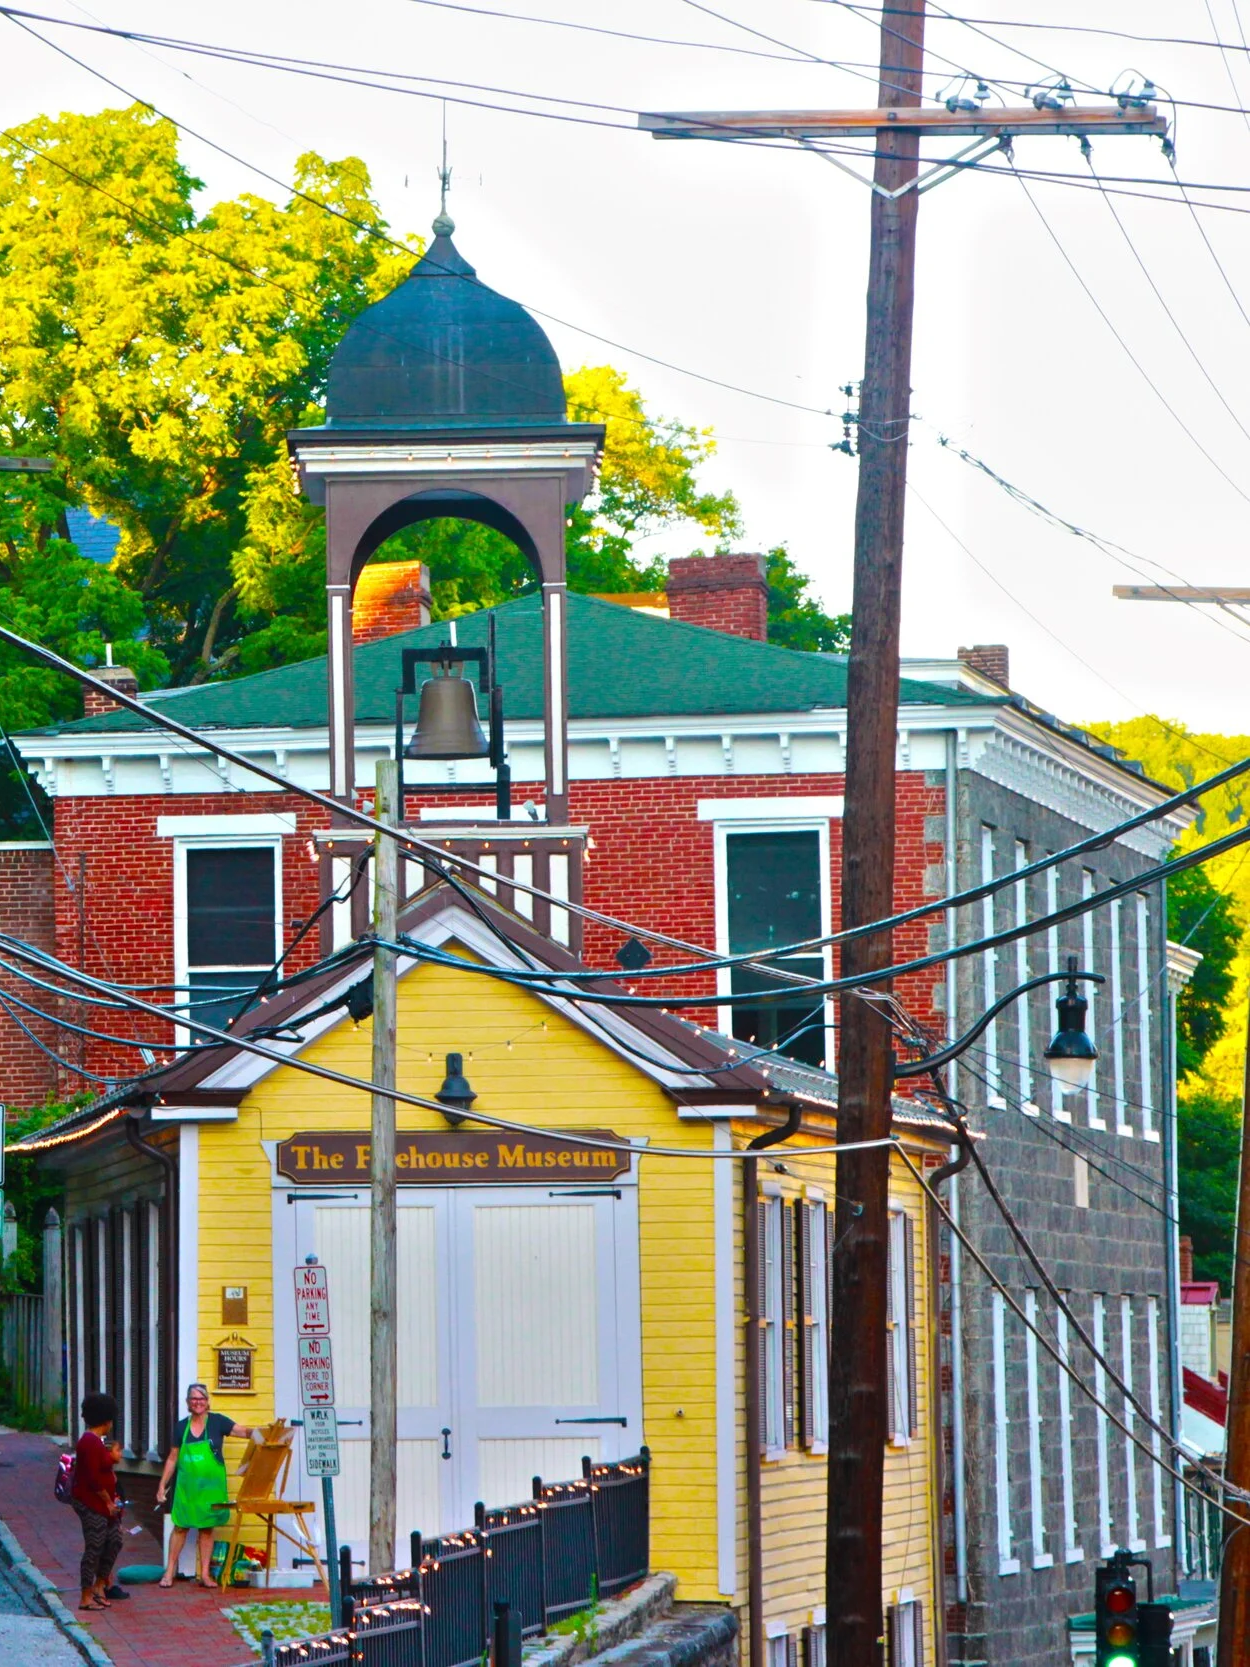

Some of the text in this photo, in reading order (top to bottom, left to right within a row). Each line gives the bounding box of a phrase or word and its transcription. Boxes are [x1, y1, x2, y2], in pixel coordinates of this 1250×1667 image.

[291, 1144, 617, 1169] The Fehouse Museum
[304, 1272, 317, 1285] NO
[296, 1287, 326, 1300] PARKING
[306, 1302, 318, 1311] ANY
[305, 1312, 321, 1321] TIME
[308, 1341, 320, 1354] NO
[301, 1357, 330, 1369] PARKING
[304, 1371, 329, 1381] HERE TO
[305, 1381, 329, 1391] CORNER
[310, 1410, 329, 1420] WALK
[309, 1459, 337, 1470] SIDEWALK
